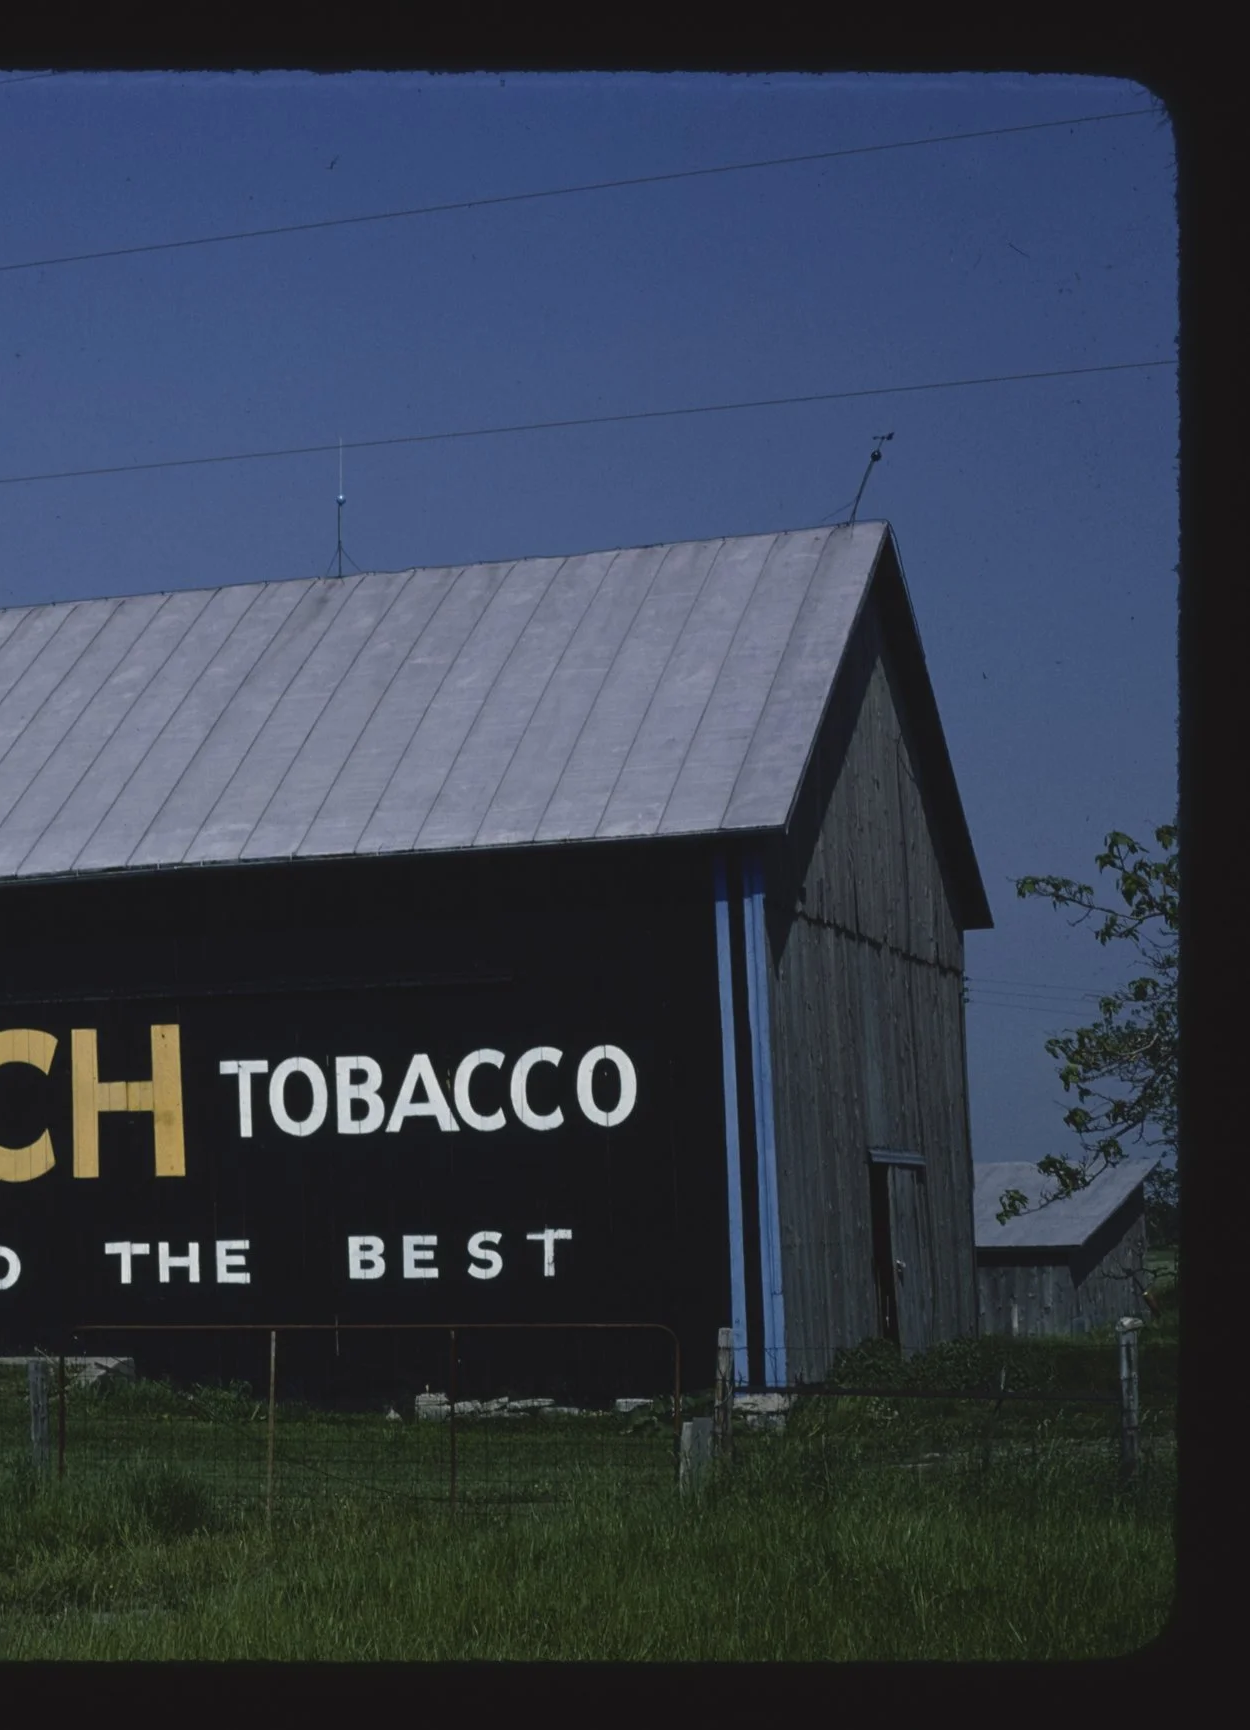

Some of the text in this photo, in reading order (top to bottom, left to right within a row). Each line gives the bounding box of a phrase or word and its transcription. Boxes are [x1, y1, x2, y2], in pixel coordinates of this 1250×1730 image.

[219, 1044, 637, 1138] TOBACCO
[104, 1239, 251, 1285] THE
[347, 1228, 573, 1281] BEST
